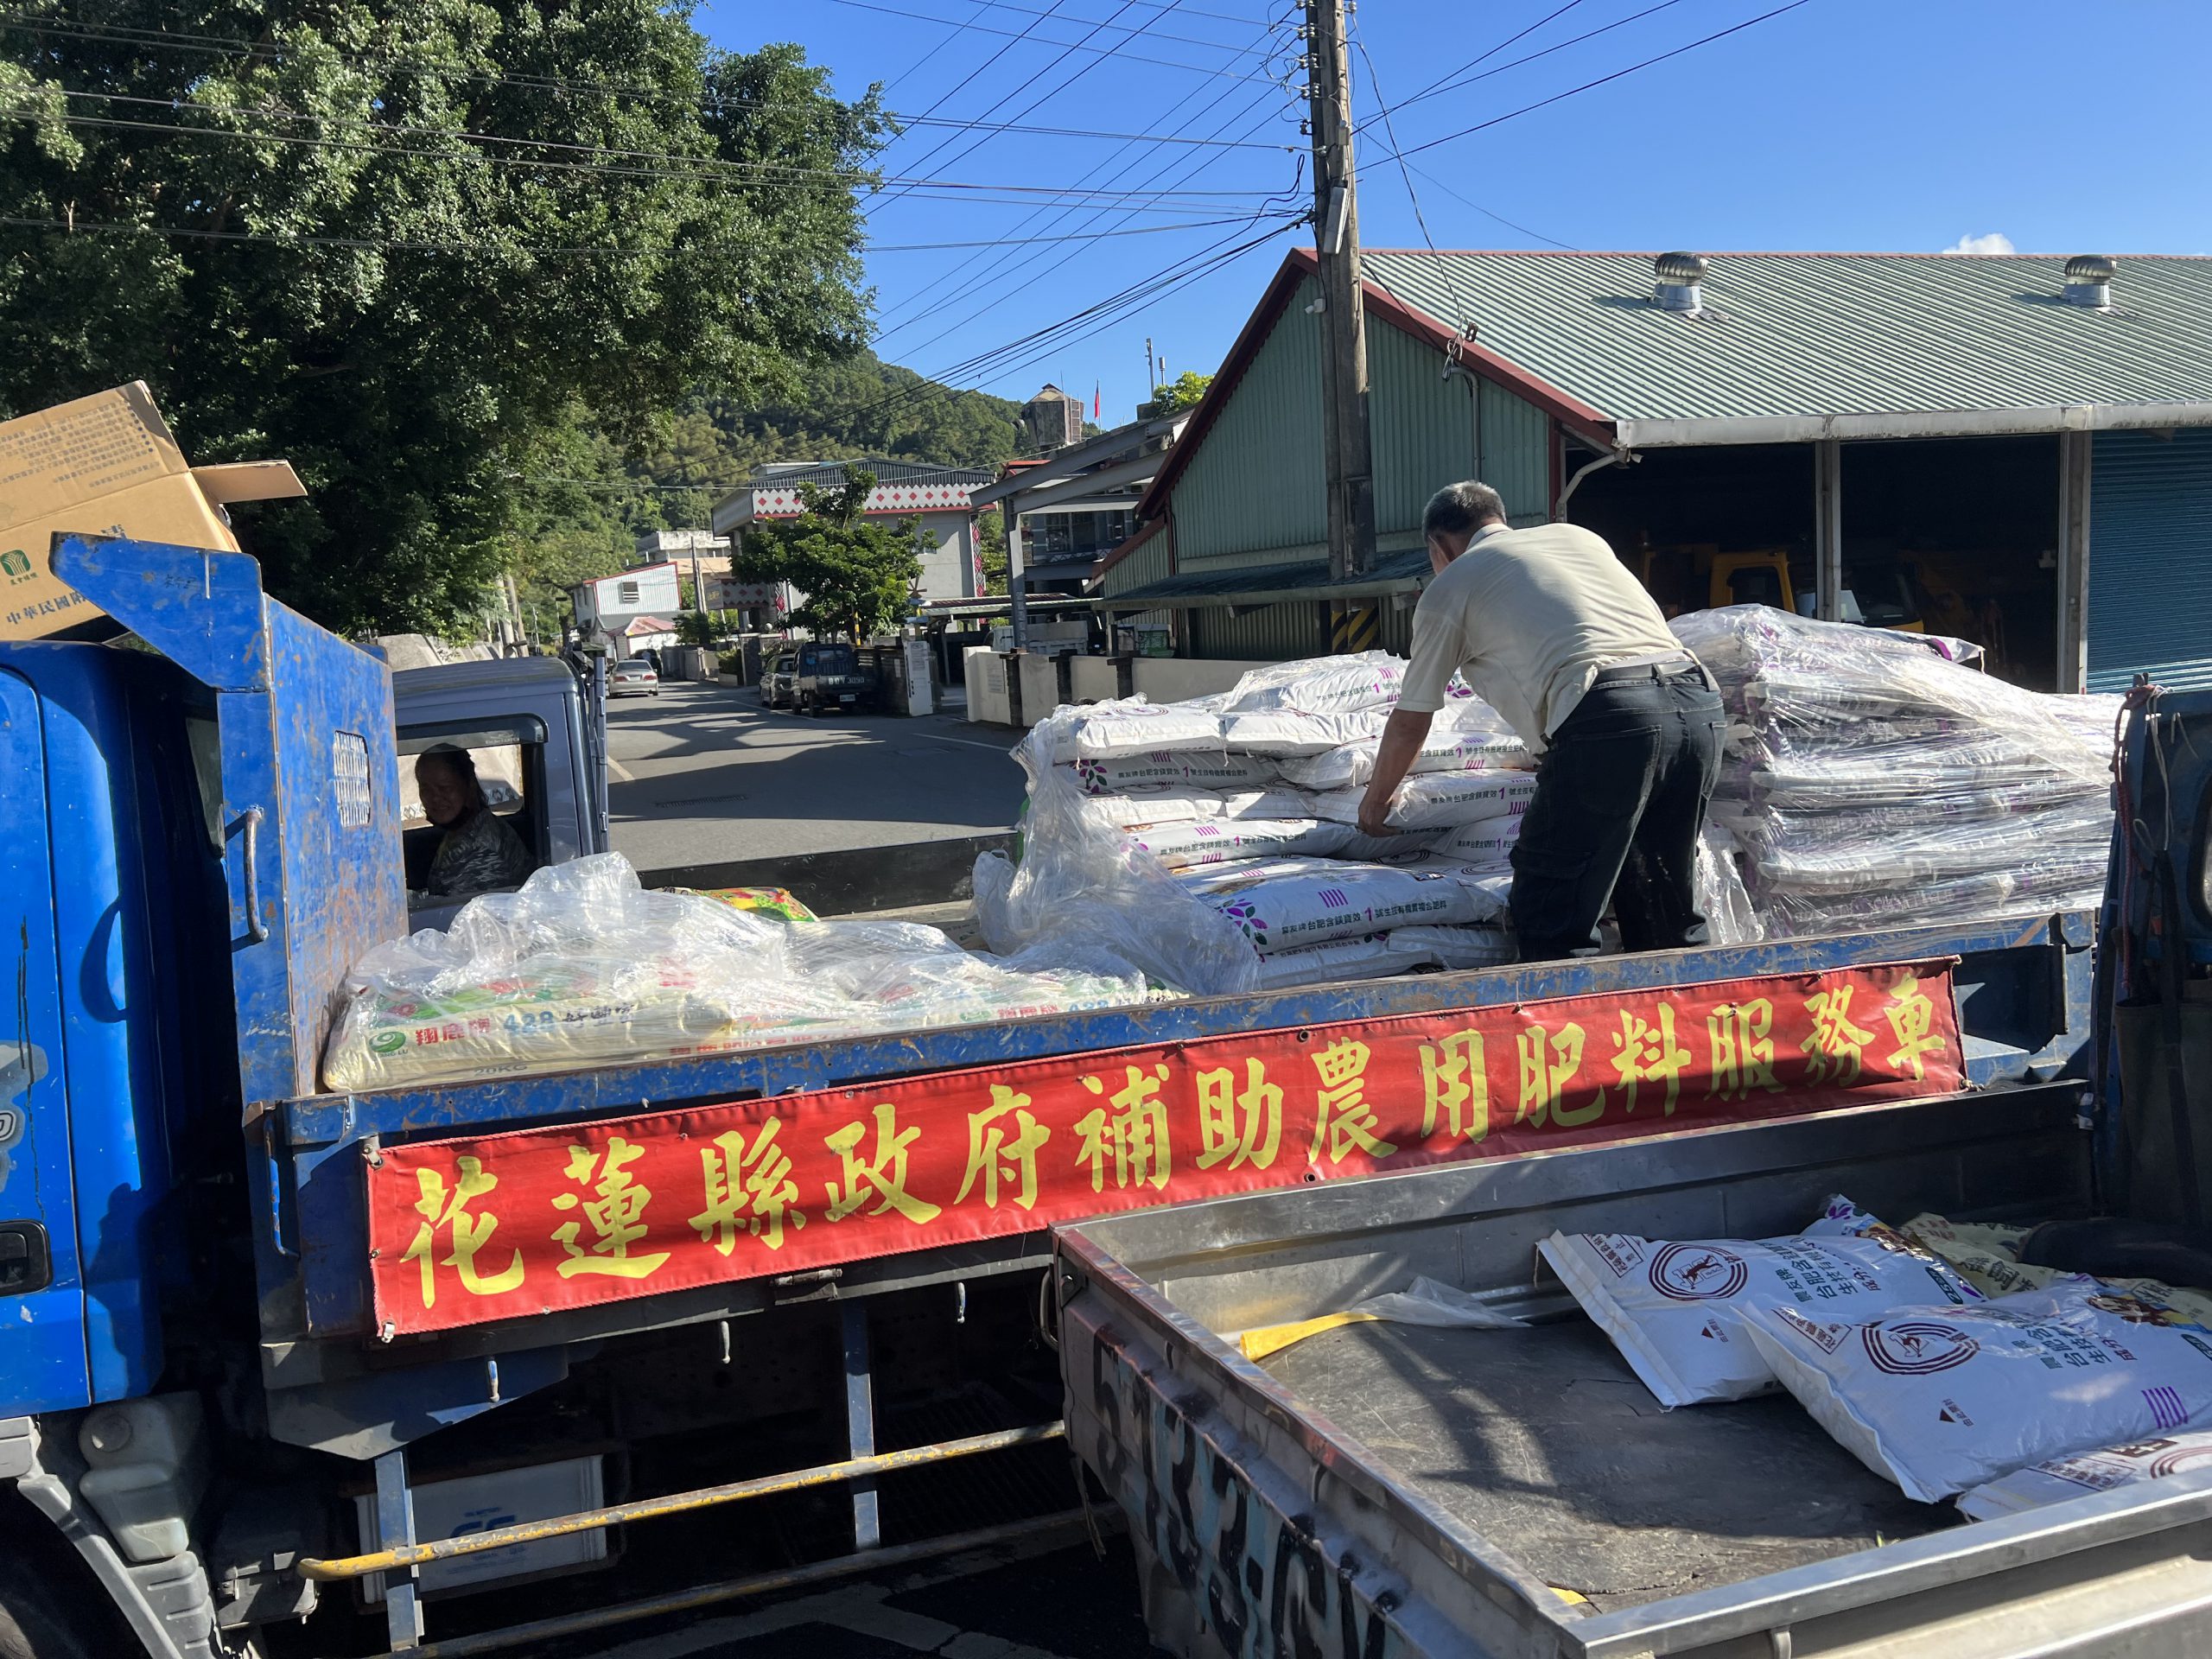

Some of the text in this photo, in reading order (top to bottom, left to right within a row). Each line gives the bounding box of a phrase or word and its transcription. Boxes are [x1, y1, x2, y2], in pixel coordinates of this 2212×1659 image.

[400, 975, 1947, 1309] 花蓮縣政府補助農用肥料服務車
